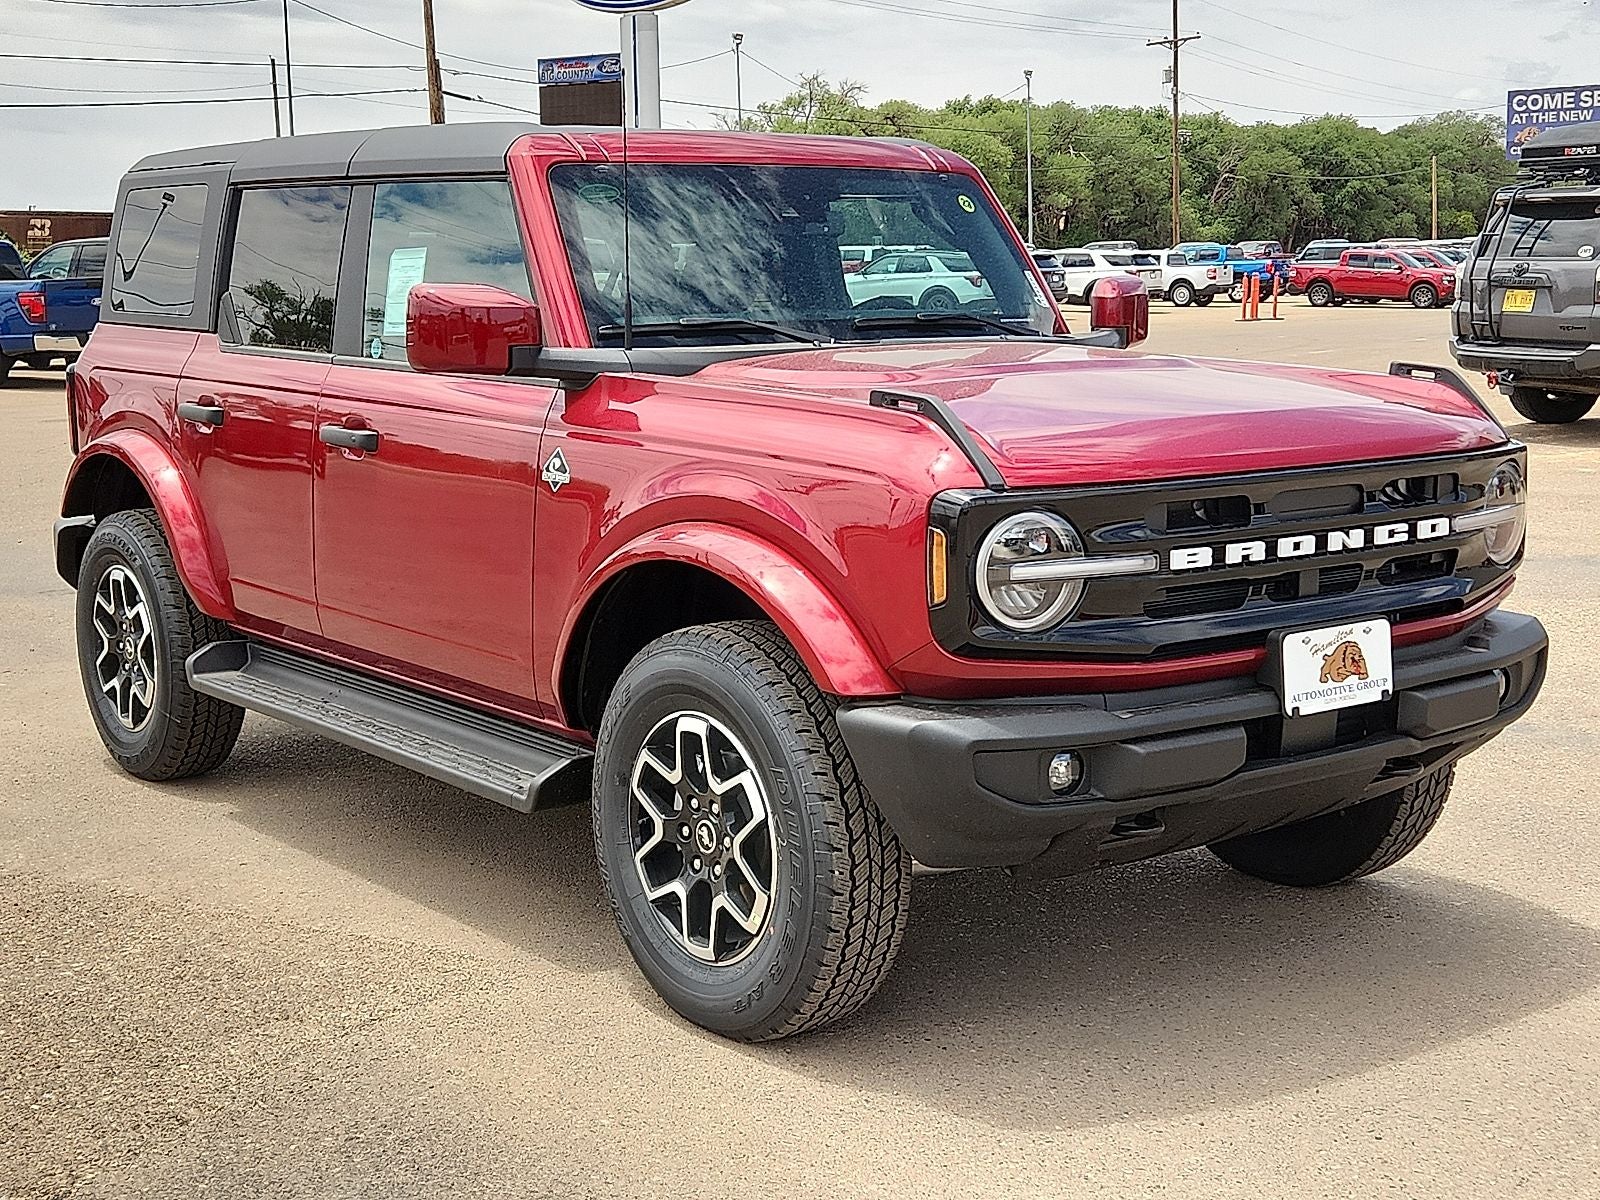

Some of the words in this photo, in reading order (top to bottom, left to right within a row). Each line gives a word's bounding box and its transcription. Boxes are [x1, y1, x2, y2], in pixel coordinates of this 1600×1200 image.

[541, 71, 554, 80] BIG
[556, 68, 594, 80] COUNTRY
[602, 60, 620, 72] Ford
[1512, 92, 1575, 111] COME
[1511, 113, 1529, 125] AT
[1530, 111, 1557, 124] THE
[1559, 109, 1593, 122] NEW
[1169, 517, 1449, 570] BRONCO
[1291, 683, 1355, 703] AUTOMOTIVE
[1356, 677, 1388, 691] GROUP
[769, 766, 803, 984] DUELER
